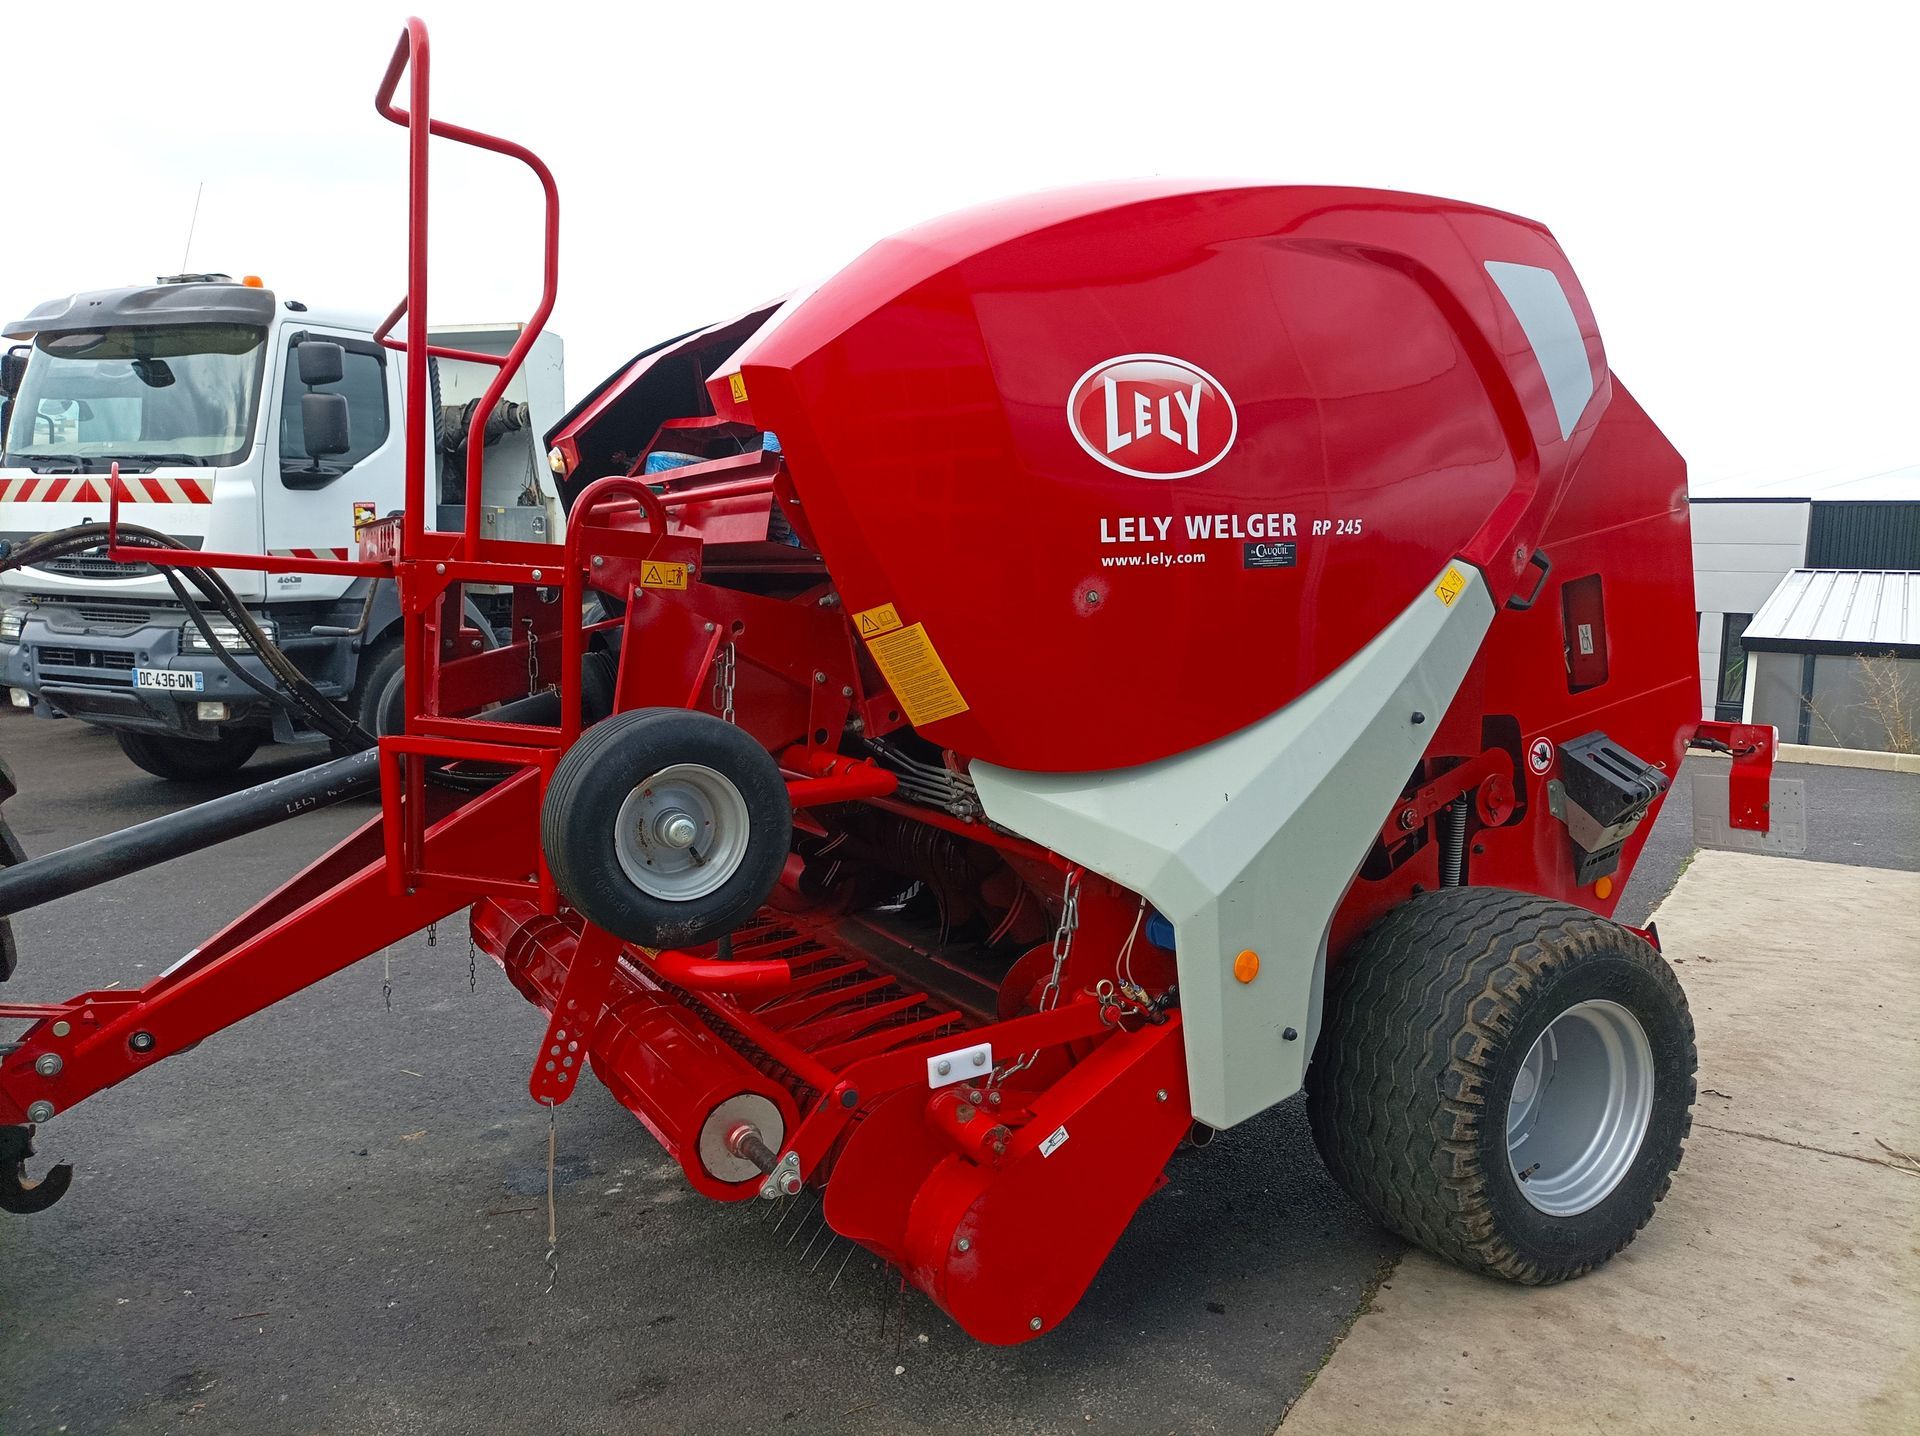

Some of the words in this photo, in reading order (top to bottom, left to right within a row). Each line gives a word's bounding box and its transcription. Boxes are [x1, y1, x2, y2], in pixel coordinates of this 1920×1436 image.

[1104, 375, 1202, 455] LELY
[1100, 516, 1173, 543] LELY
[1184, 513, 1297, 540] WELGER
[1311, 520, 1332, 536] RP
[1336, 519, 1363, 535] 245
[1101, 552, 1206, 568] www.lely.com
[139, 671, 193, 688] DC-436-QN
